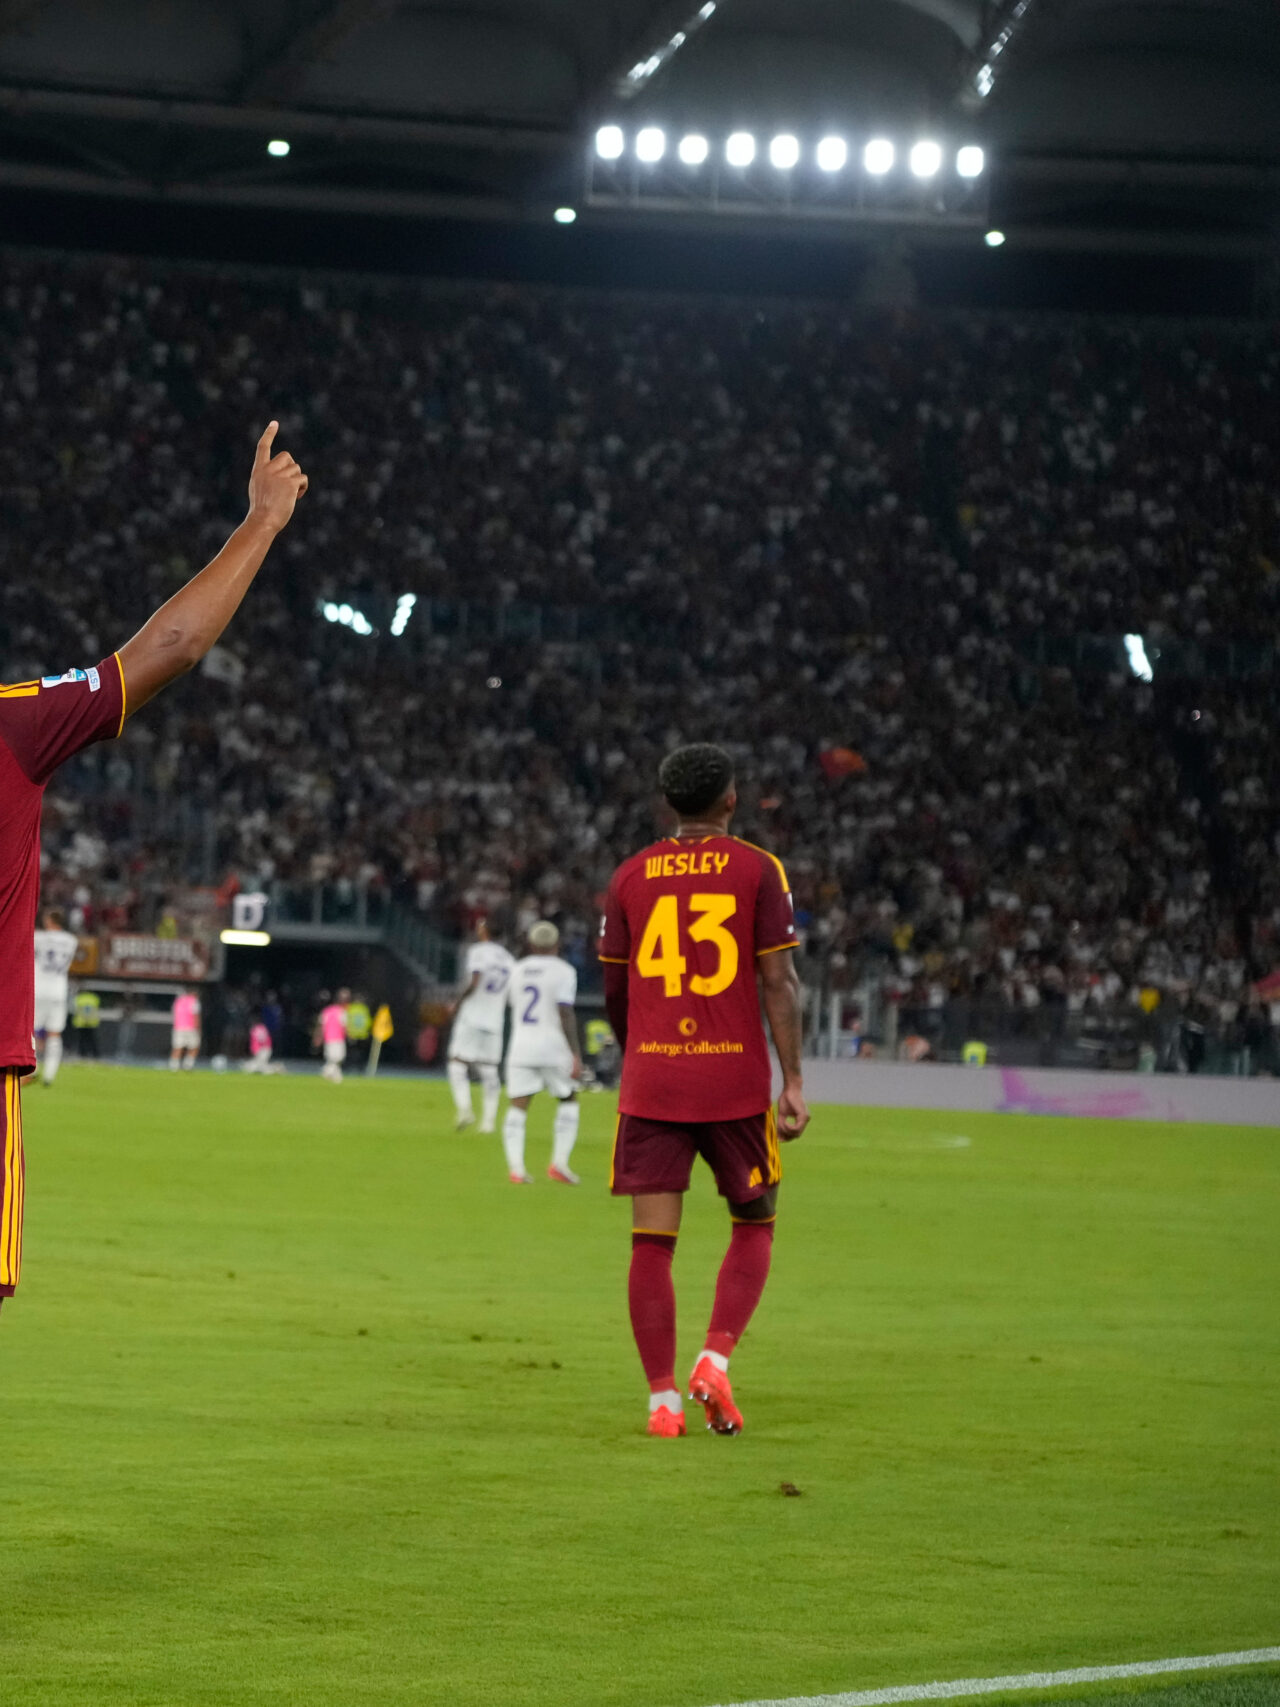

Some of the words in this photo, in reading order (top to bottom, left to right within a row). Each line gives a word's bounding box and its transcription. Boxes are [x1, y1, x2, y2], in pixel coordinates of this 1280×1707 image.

[646, 852, 730, 879] WESLEY
[637, 893, 739, 997] 43
[523, 985, 540, 1024] 2
[637, 1041, 683, 1057] Auberge
[685, 1041, 744, 1055] Collection
